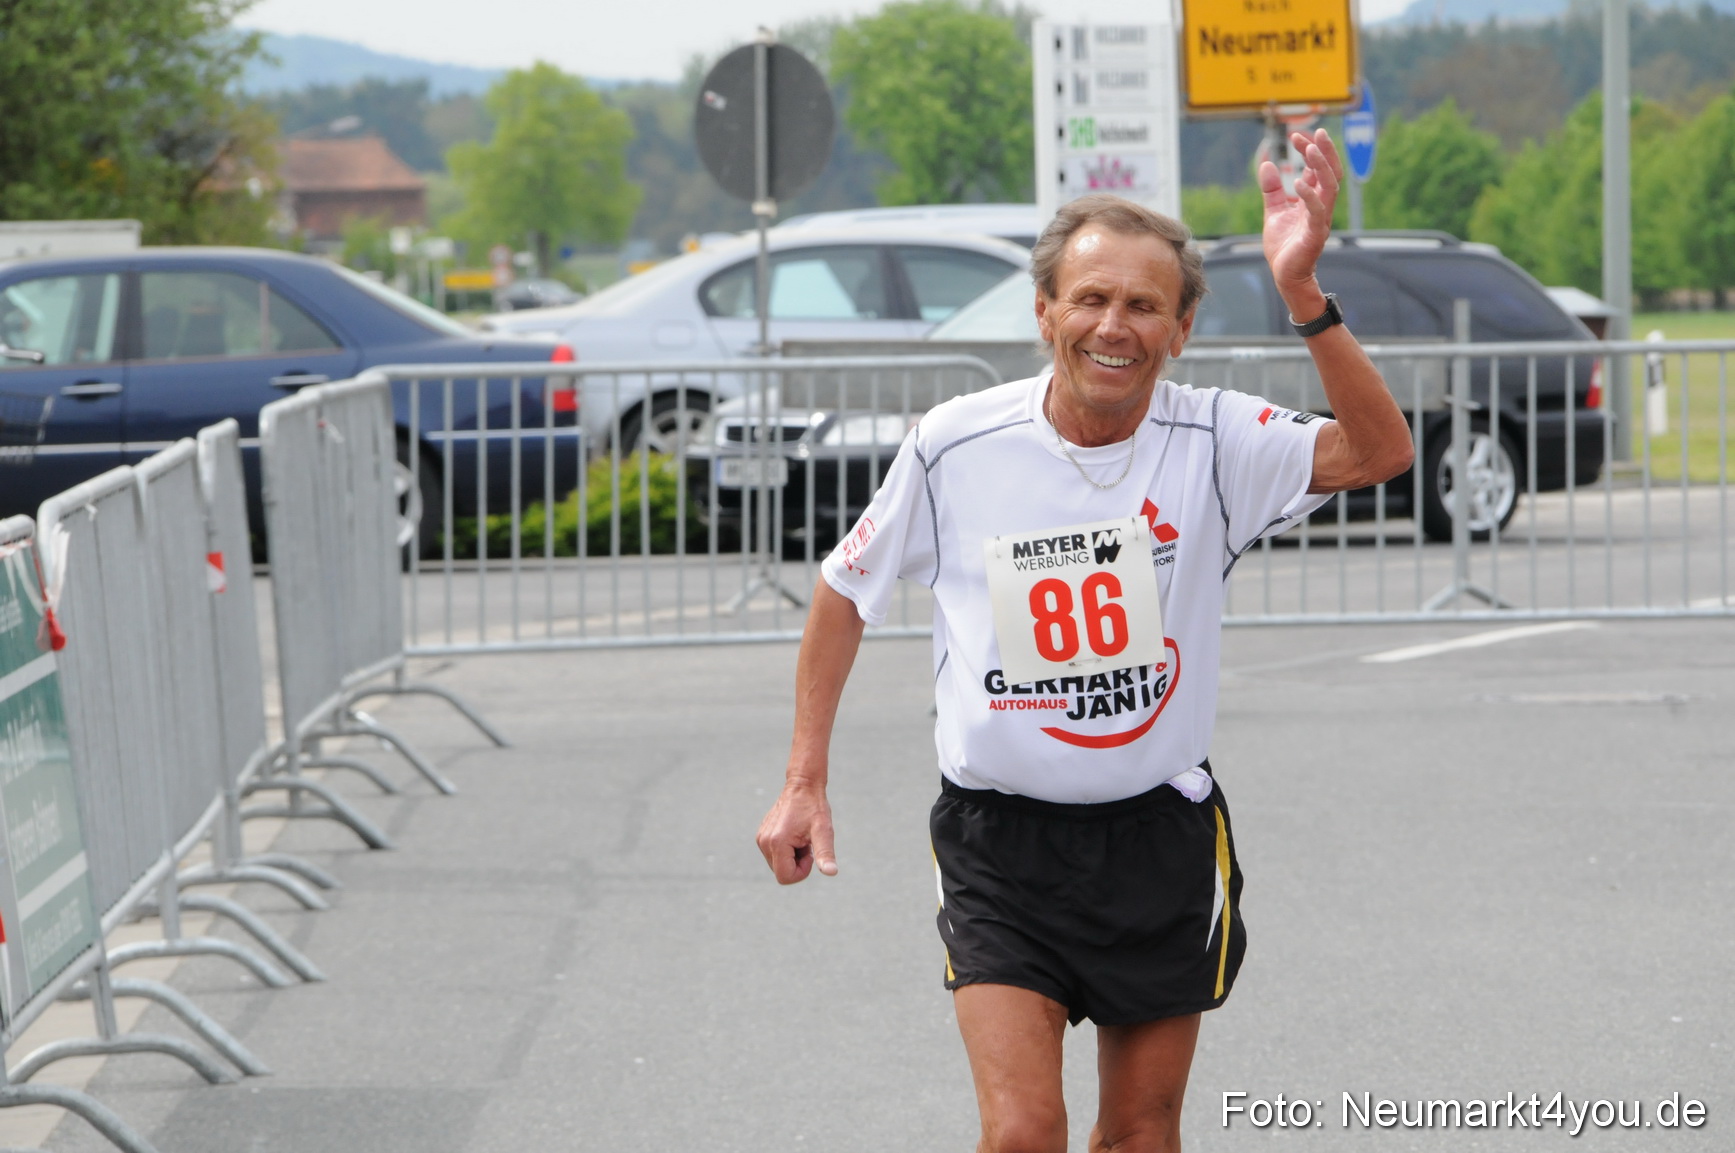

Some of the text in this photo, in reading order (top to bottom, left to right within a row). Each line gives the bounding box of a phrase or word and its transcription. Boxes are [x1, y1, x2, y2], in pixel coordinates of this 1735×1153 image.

[1199, 23, 1335, 56] Neumarkt
[1012, 533, 1088, 560] MEYER
[1013, 551, 1090, 572] WERBUNG
[1153, 555, 1175, 567] TORS
[1029, 571, 1129, 662] 86
[988, 698, 1068, 711] AUTOHAUS
[1066, 673, 1168, 721] JÄNIG
